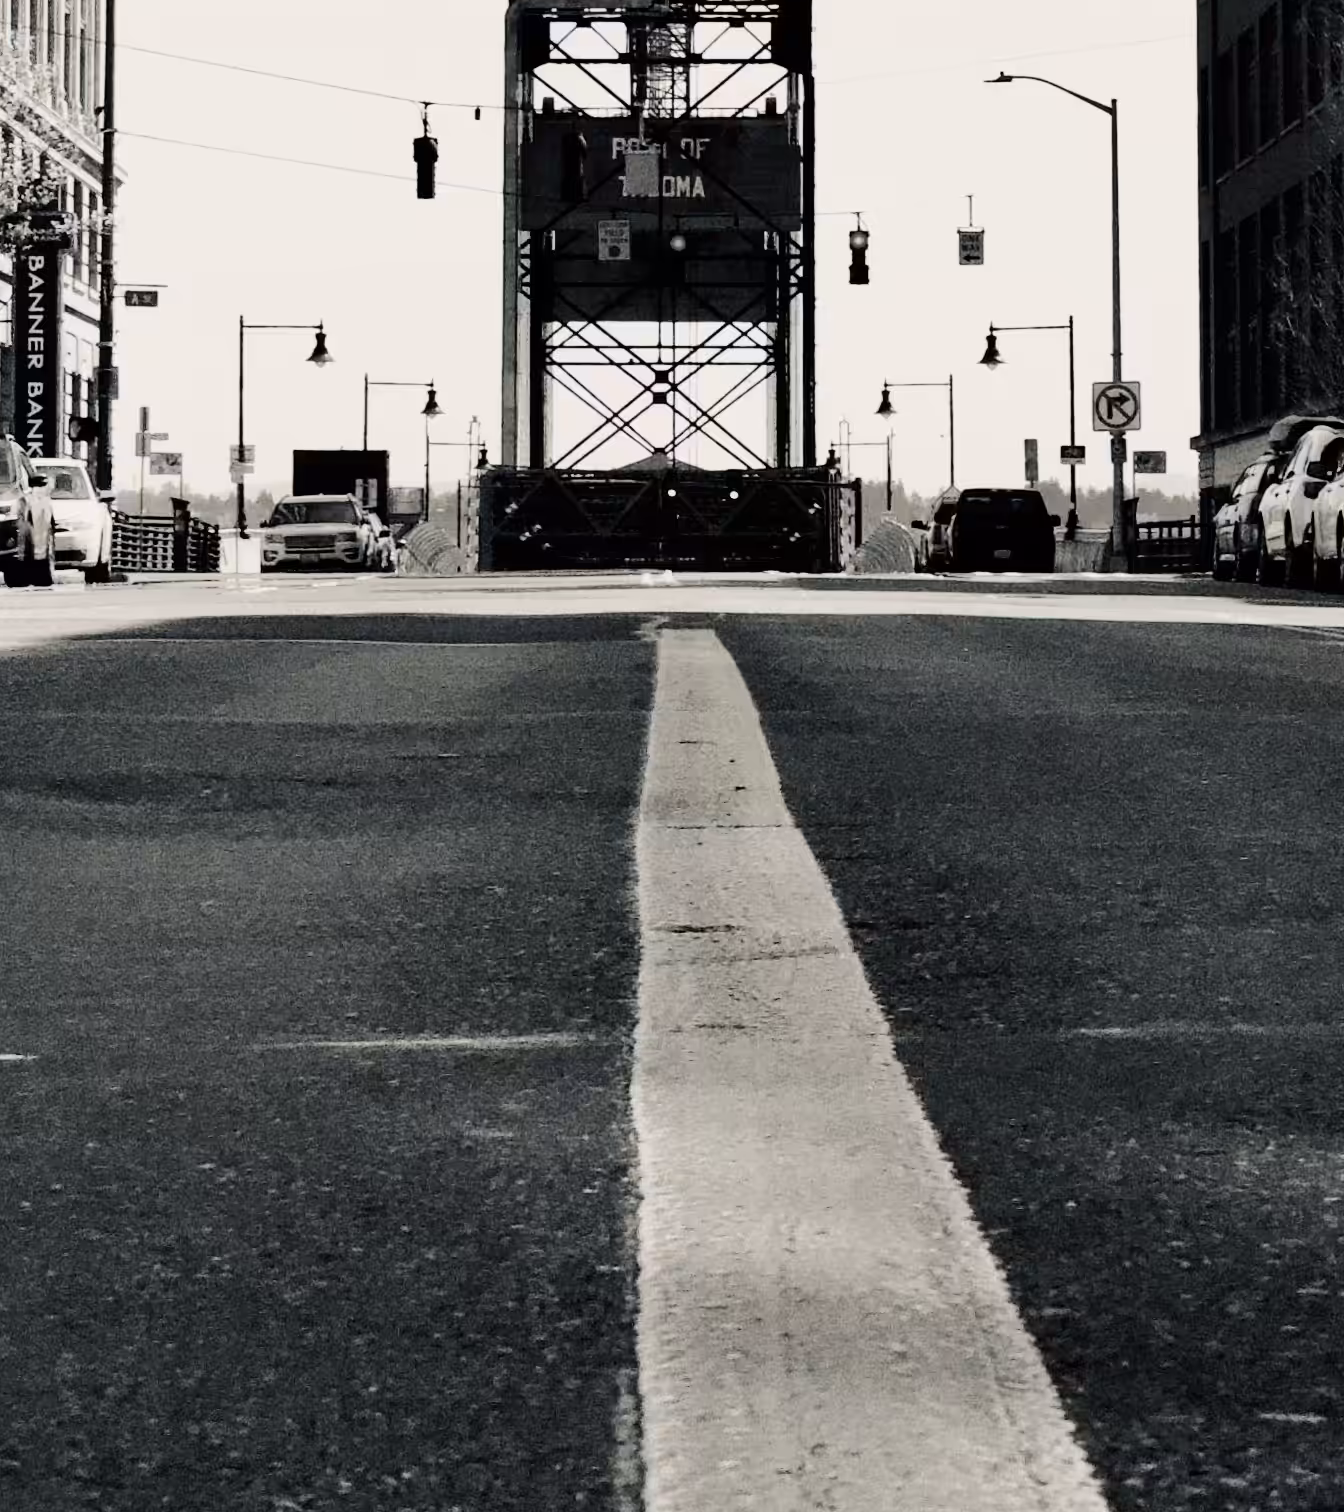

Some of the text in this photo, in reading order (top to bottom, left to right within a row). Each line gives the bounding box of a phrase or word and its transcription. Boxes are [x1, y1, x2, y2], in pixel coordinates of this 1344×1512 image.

[680, 137, 711, 160] OF
[618, 175, 706, 198] TOMA
[27, 255, 45, 458] BANNER BANK
